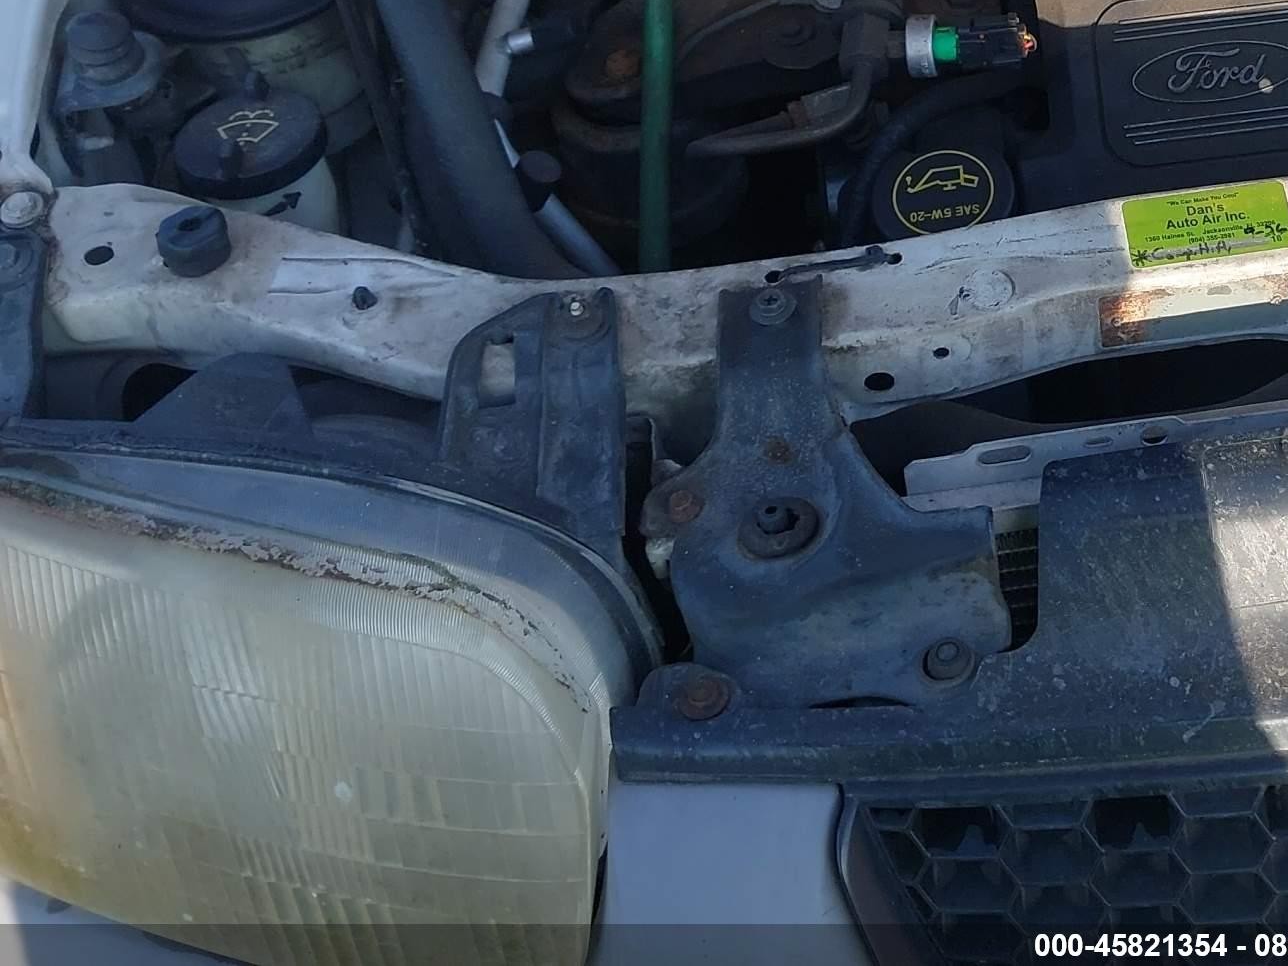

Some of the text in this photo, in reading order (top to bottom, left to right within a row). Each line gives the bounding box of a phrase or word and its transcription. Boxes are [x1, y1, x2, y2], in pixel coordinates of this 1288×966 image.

[1167, 47, 1265, 94] Ford
[910, 204, 980, 223] SAE 5W-20
[1186, 202, 1225, 216] Dan's
[1166, 211, 1250, 230] Auto Air Inc.
[1161, 233, 1185, 241] Haines
[1203, 224, 1243, 235] Jacksonville
